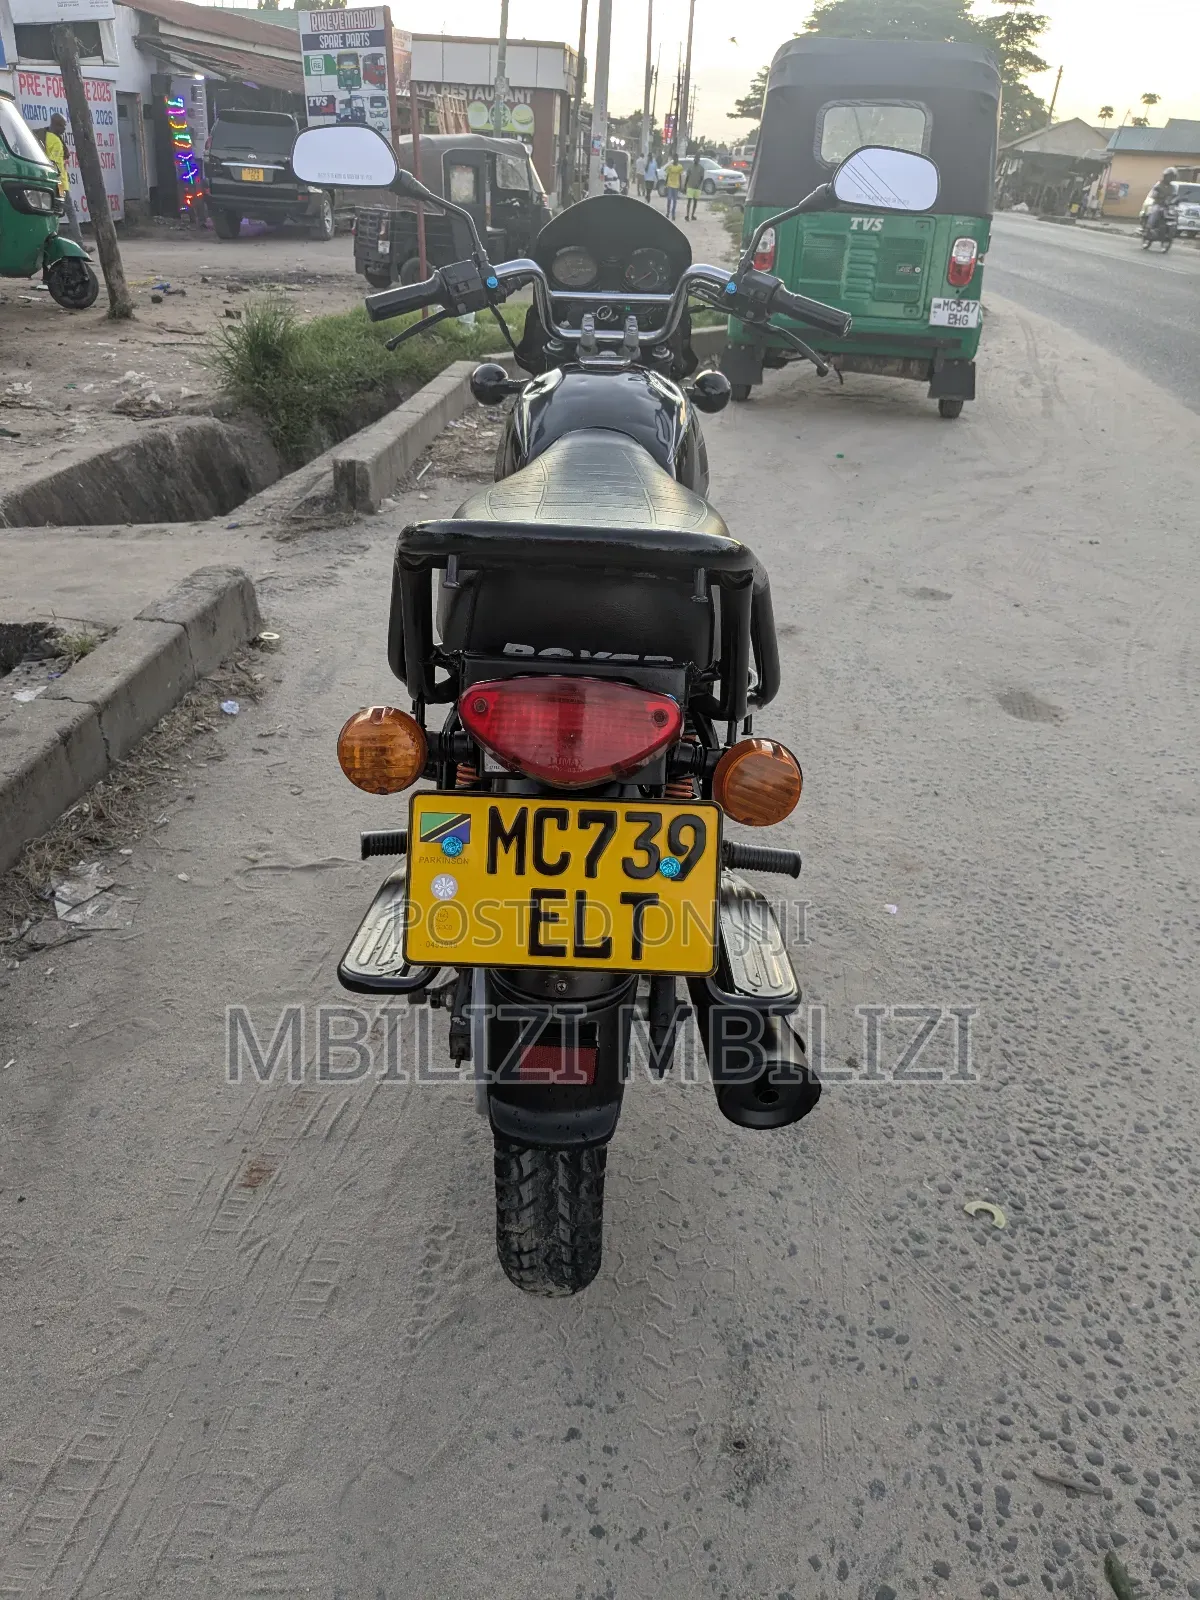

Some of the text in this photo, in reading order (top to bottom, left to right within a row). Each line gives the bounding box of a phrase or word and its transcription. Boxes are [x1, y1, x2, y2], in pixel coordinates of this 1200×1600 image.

[310, 9, 377, 32] RWEYEMAMU
[319, 32, 370, 49] SPARE PARTS
[18, 73, 67, 99] PRE-FOR
[92, 81, 112, 102] 2025
[441, 83, 534, 104] RESTAUANT
[308, 96, 328, 107] TVS
[22, 103, 48, 121] KIDATO
[96, 109, 114, 126] 2026
[850, 217, 885, 231] TVS
[942, 299, 978, 314] MC547
[486, 804, 707, 882] MC739
[418, 856, 470, 865] PARKINSON
[528, 887, 660, 961] ELT
